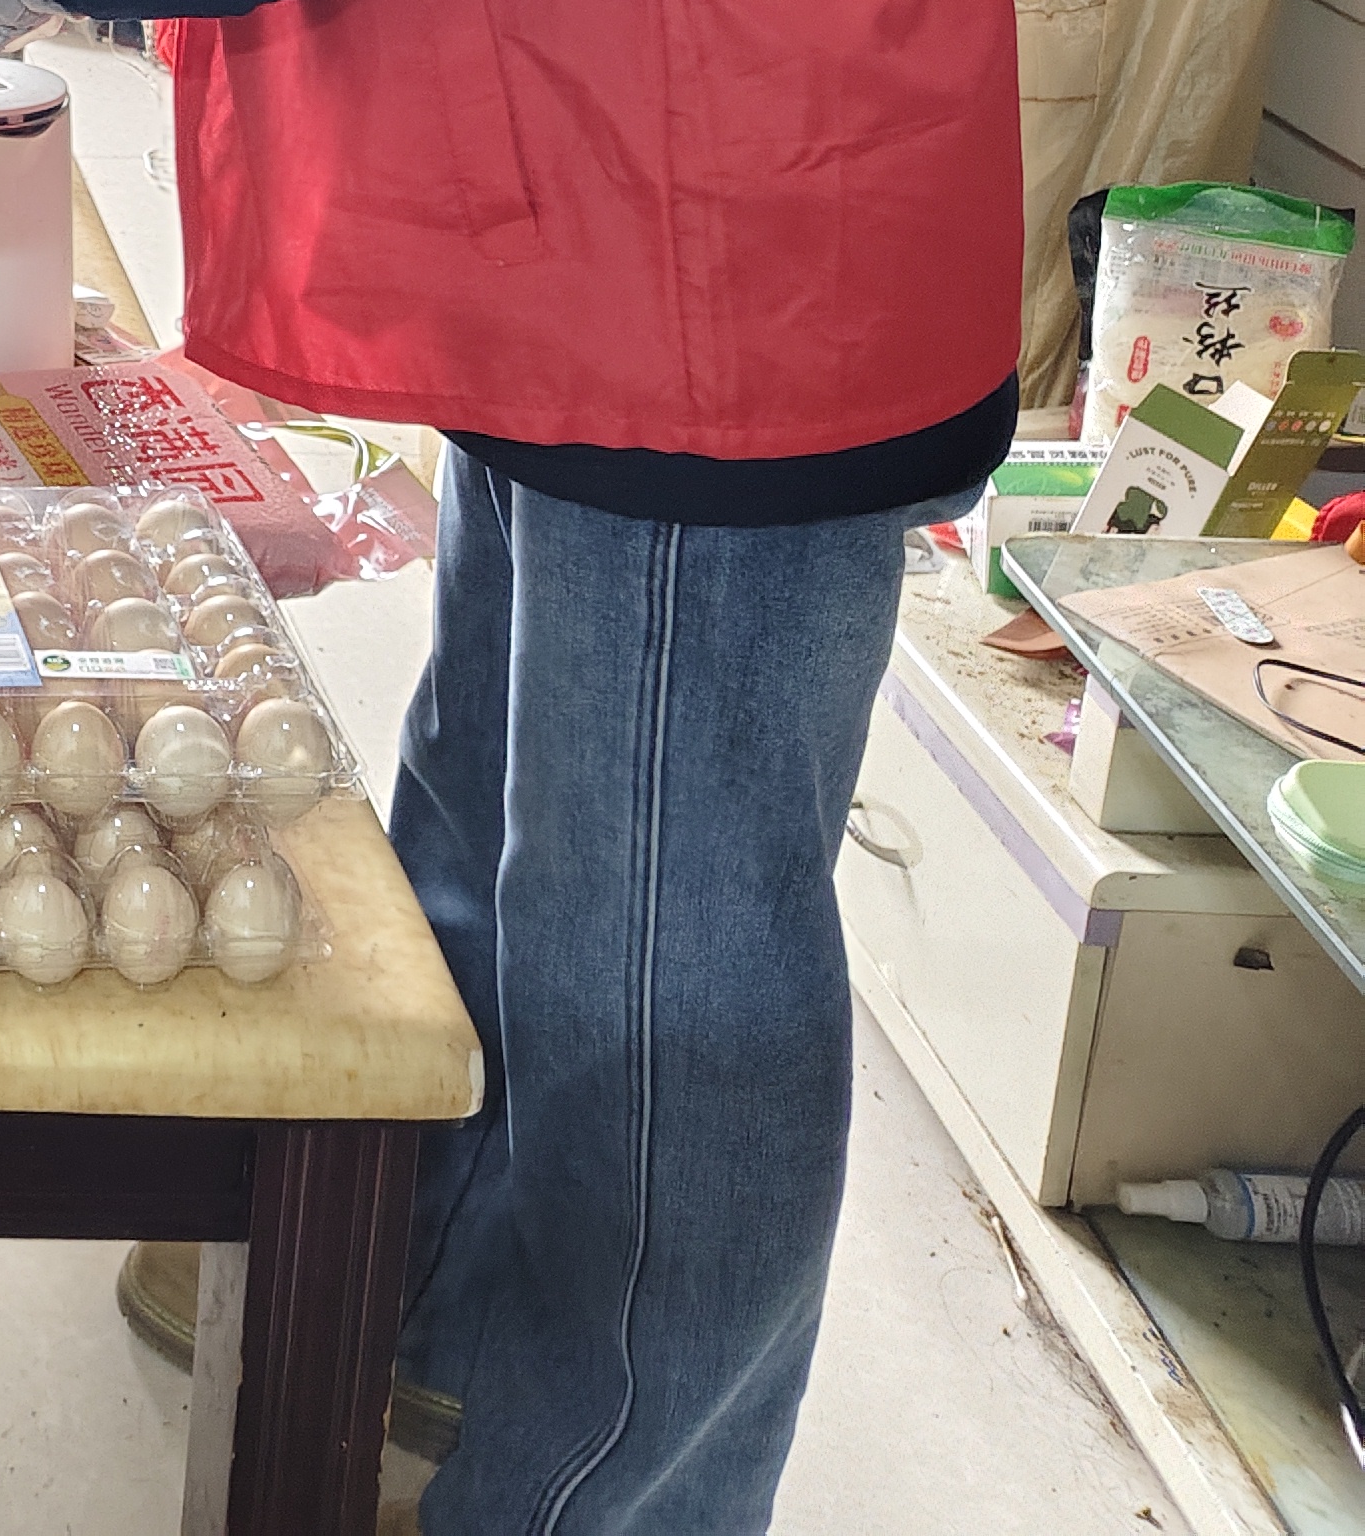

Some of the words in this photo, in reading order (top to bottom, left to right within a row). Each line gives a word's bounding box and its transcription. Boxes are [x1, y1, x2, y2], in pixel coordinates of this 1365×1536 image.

[44, 383, 112, 454] Wonder
[1129, 447, 1156, 459] LUST
[1159, 449, 1181, 466] FOR
[1180, 464, 1198, 493] PURE
